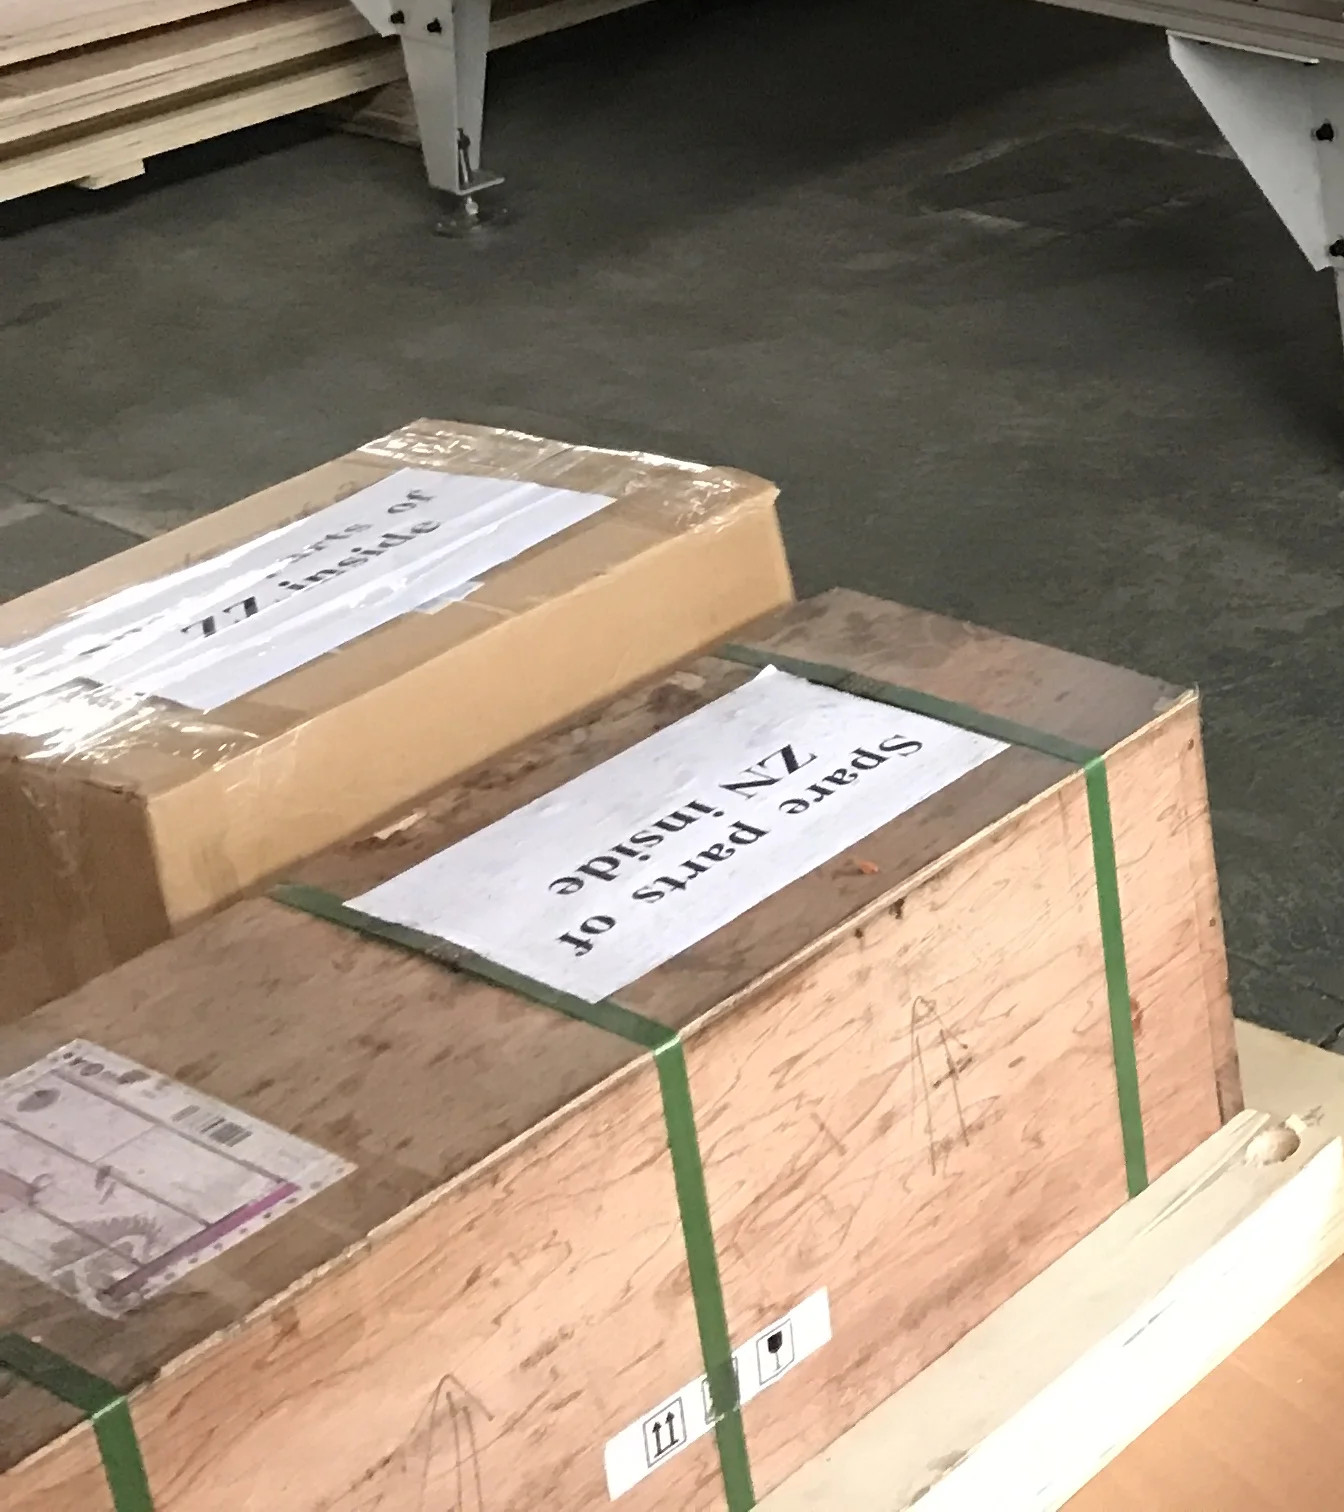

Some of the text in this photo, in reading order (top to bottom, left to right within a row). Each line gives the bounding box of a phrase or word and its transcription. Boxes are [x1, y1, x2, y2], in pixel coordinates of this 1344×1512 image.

[265, 489, 435, 579] arts of
[278, 520, 442, 590] inside
[548, 744, 818, 896] ZN inside
[557, 734, 924, 957] Spare parts of
